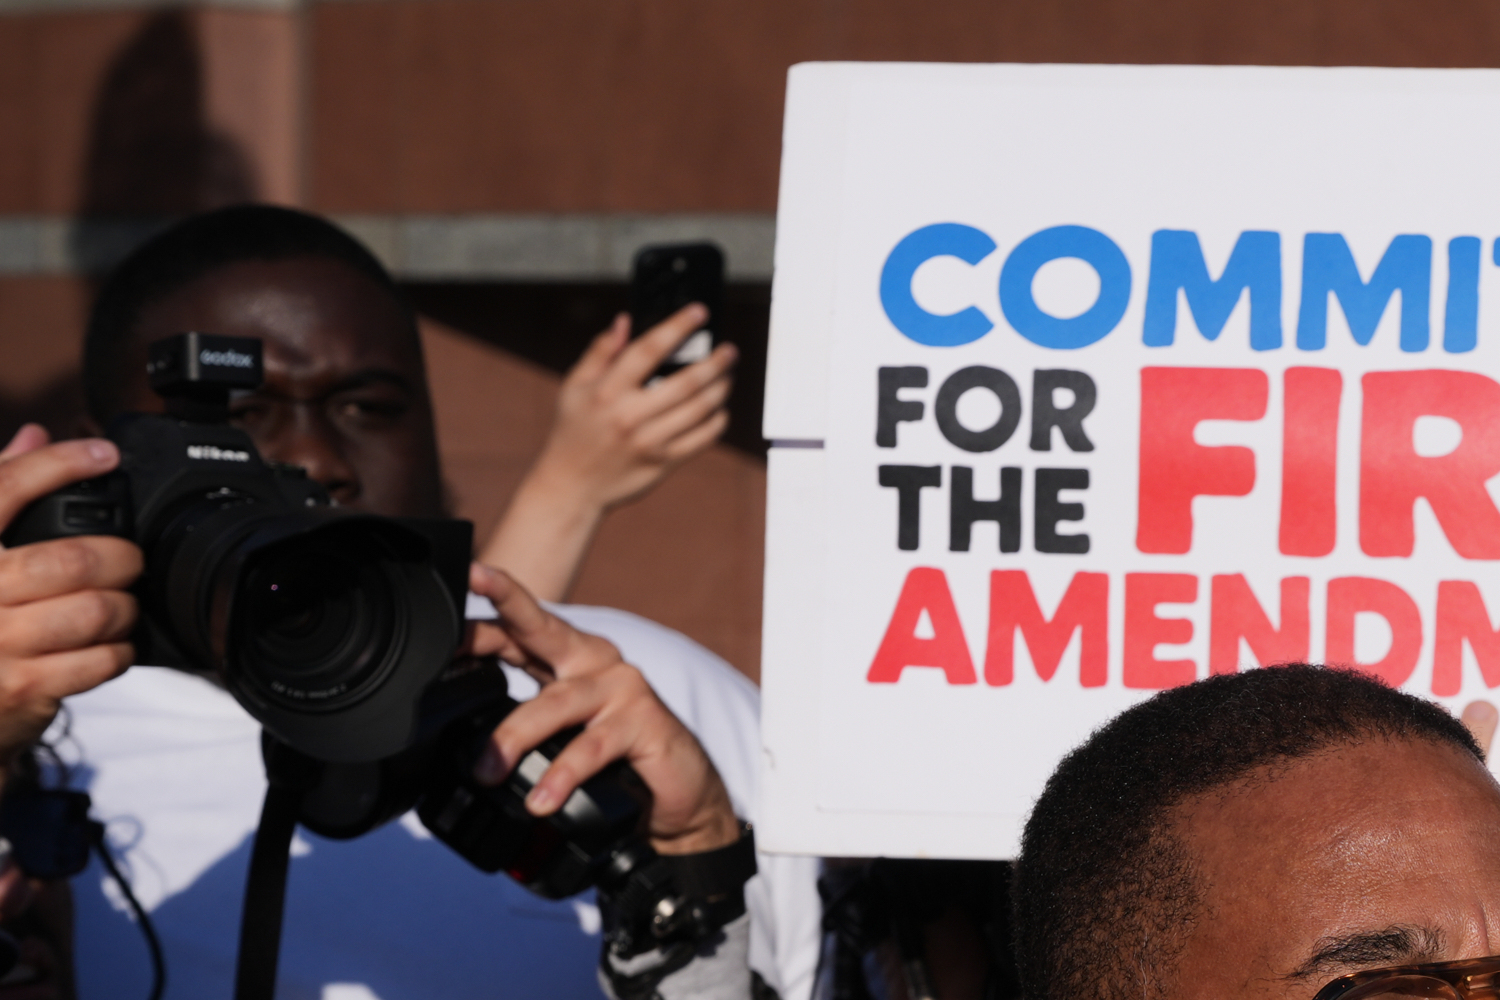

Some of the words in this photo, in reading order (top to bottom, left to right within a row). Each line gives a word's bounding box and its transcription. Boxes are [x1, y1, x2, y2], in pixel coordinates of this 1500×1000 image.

[875, 365, 1097, 453] FOR
[187, 445, 250, 462] Nikon
[878, 464, 1091, 555] THE
